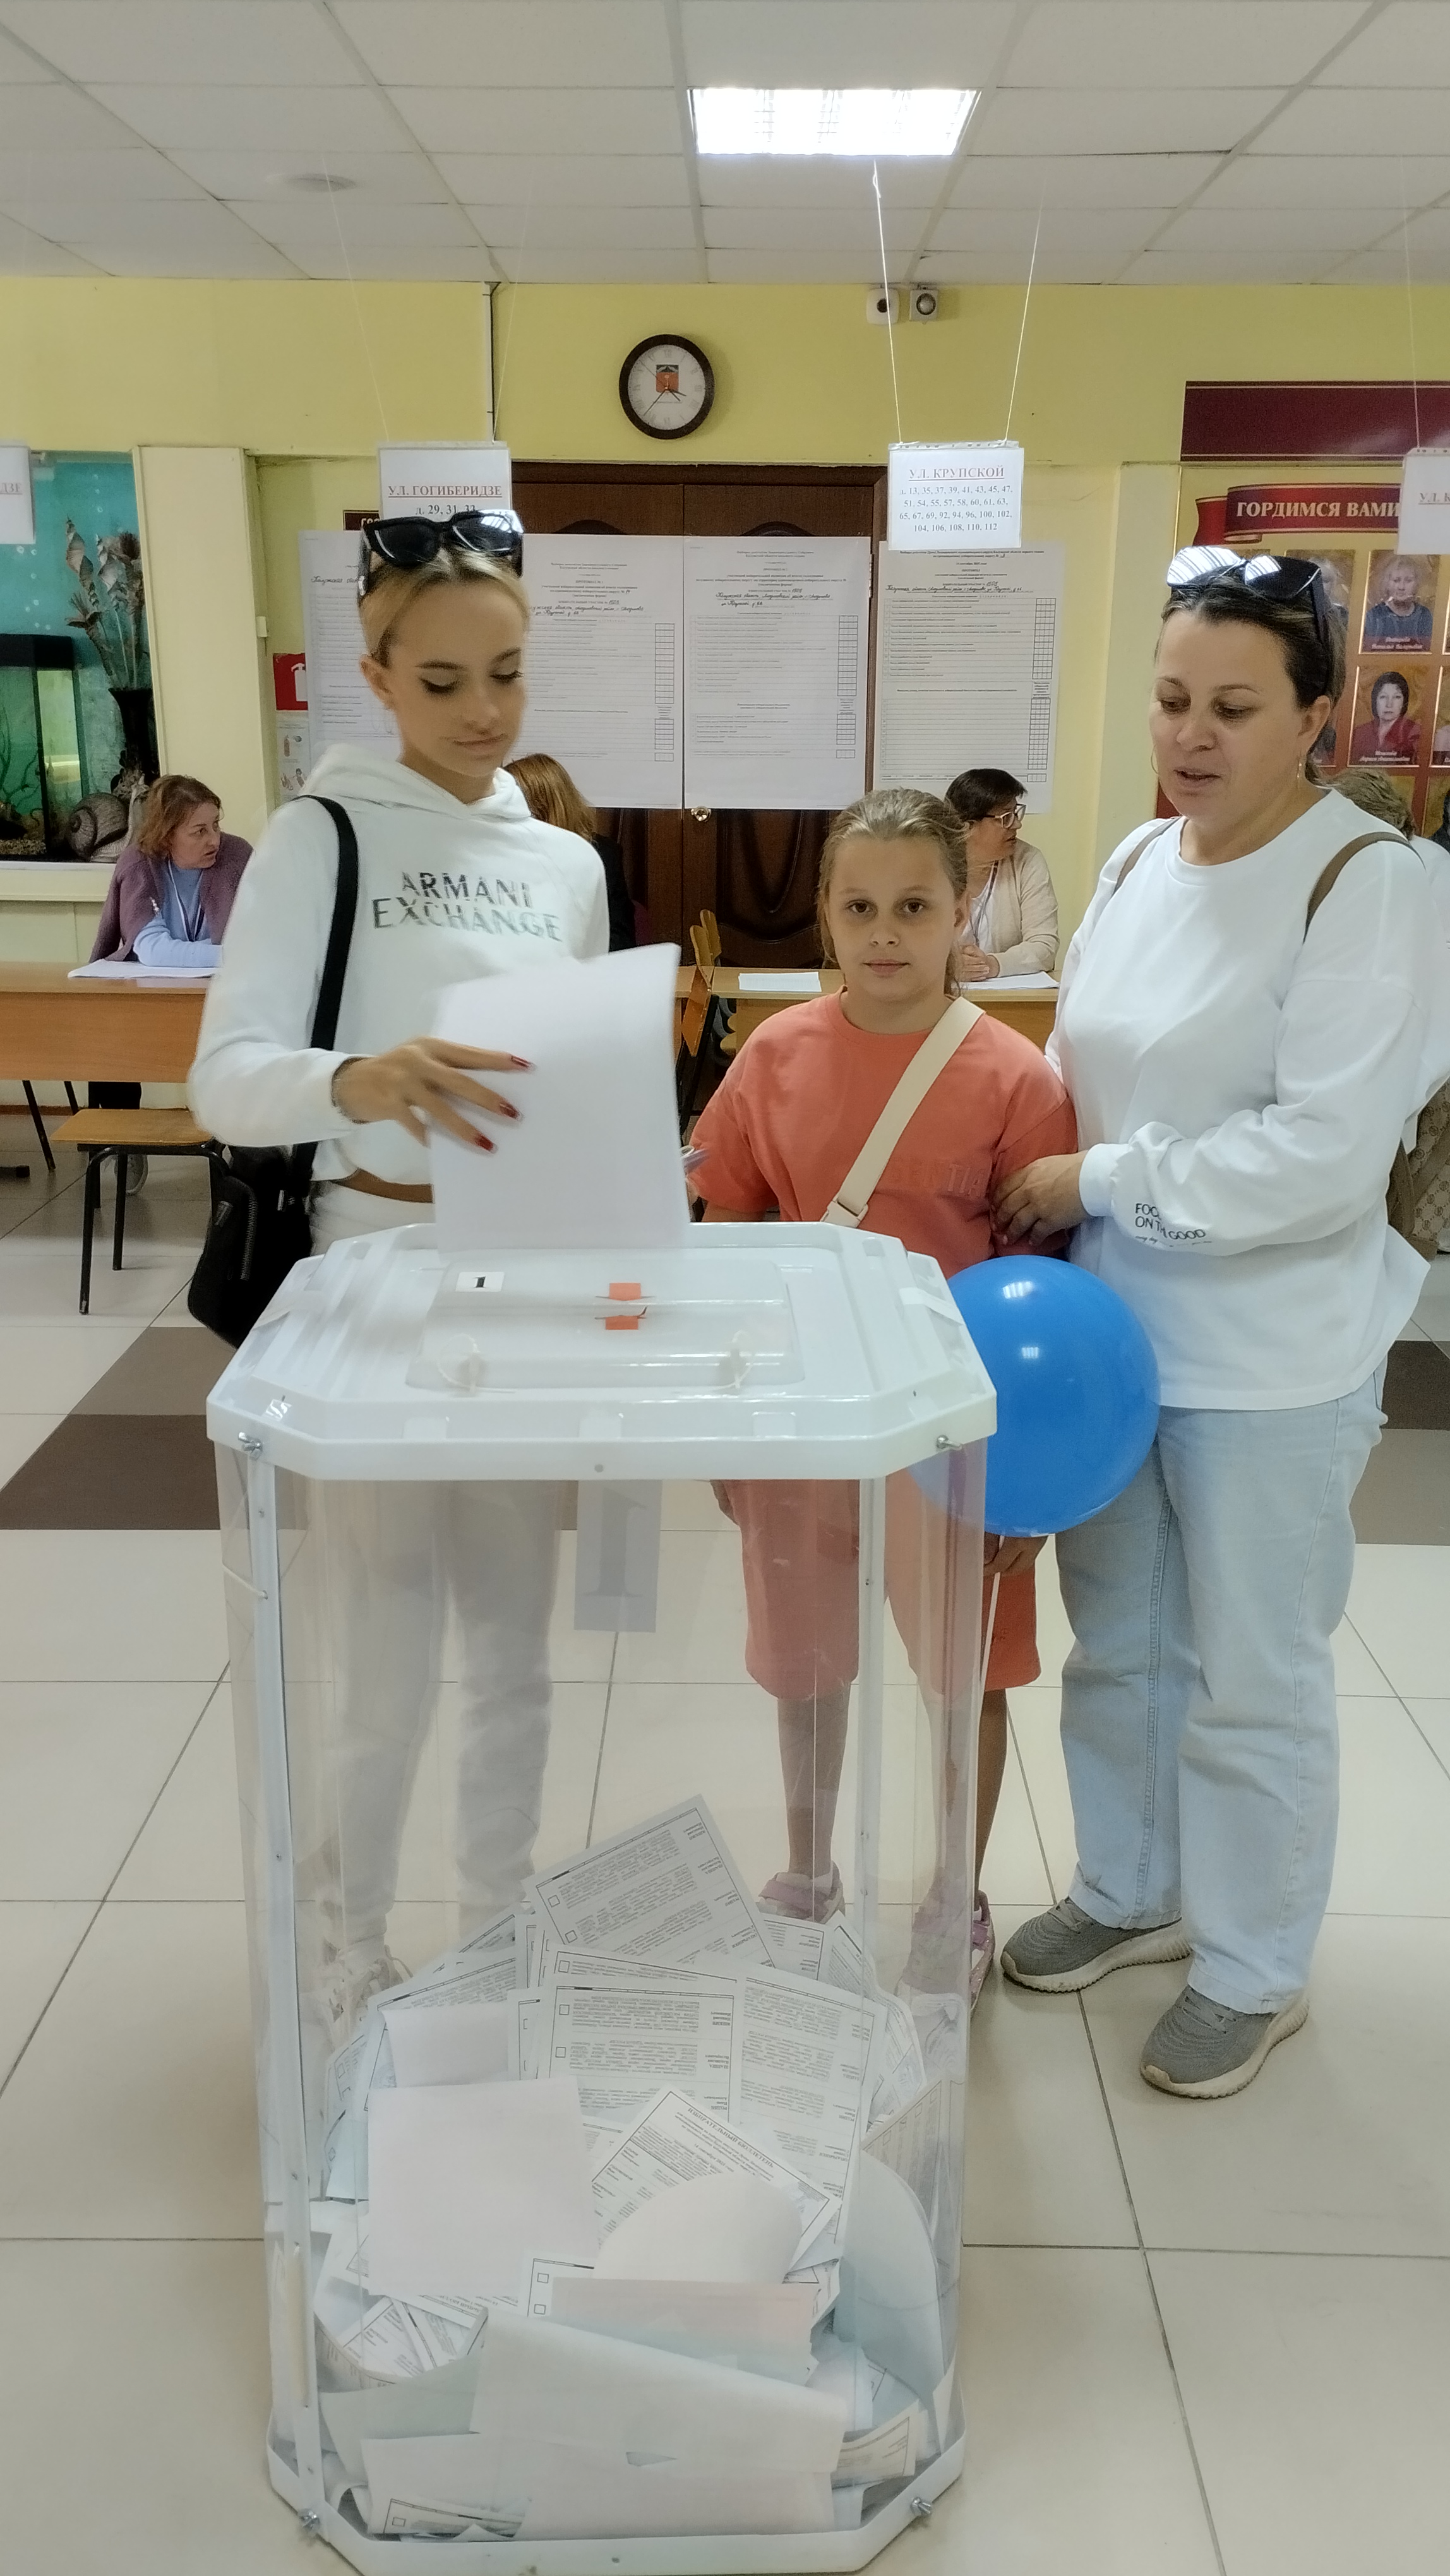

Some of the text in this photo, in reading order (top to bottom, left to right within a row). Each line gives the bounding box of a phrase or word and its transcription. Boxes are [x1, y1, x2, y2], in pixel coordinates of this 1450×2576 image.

[909, 465, 1004, 479] УЛ. КРУПСКОЙ
[388, 486, 502, 496] УЛ. ГОГИБЕРИДЗЕ
[415, 507, 425, 515] д.
[428, 504, 443, 515] 29,
[1237, 502, 1340, 518] ГОРДИМСЯ
[402, 871, 533, 909] ARMANI
[371, 896, 563, 942] EXCHANGE
[1135, 1203, 1161, 1220] FOC
[1135, 1216, 1153, 1229] ON
[1168, 1229, 1206, 1239] GOOD
[472, 1275, 486, 1289] 1
